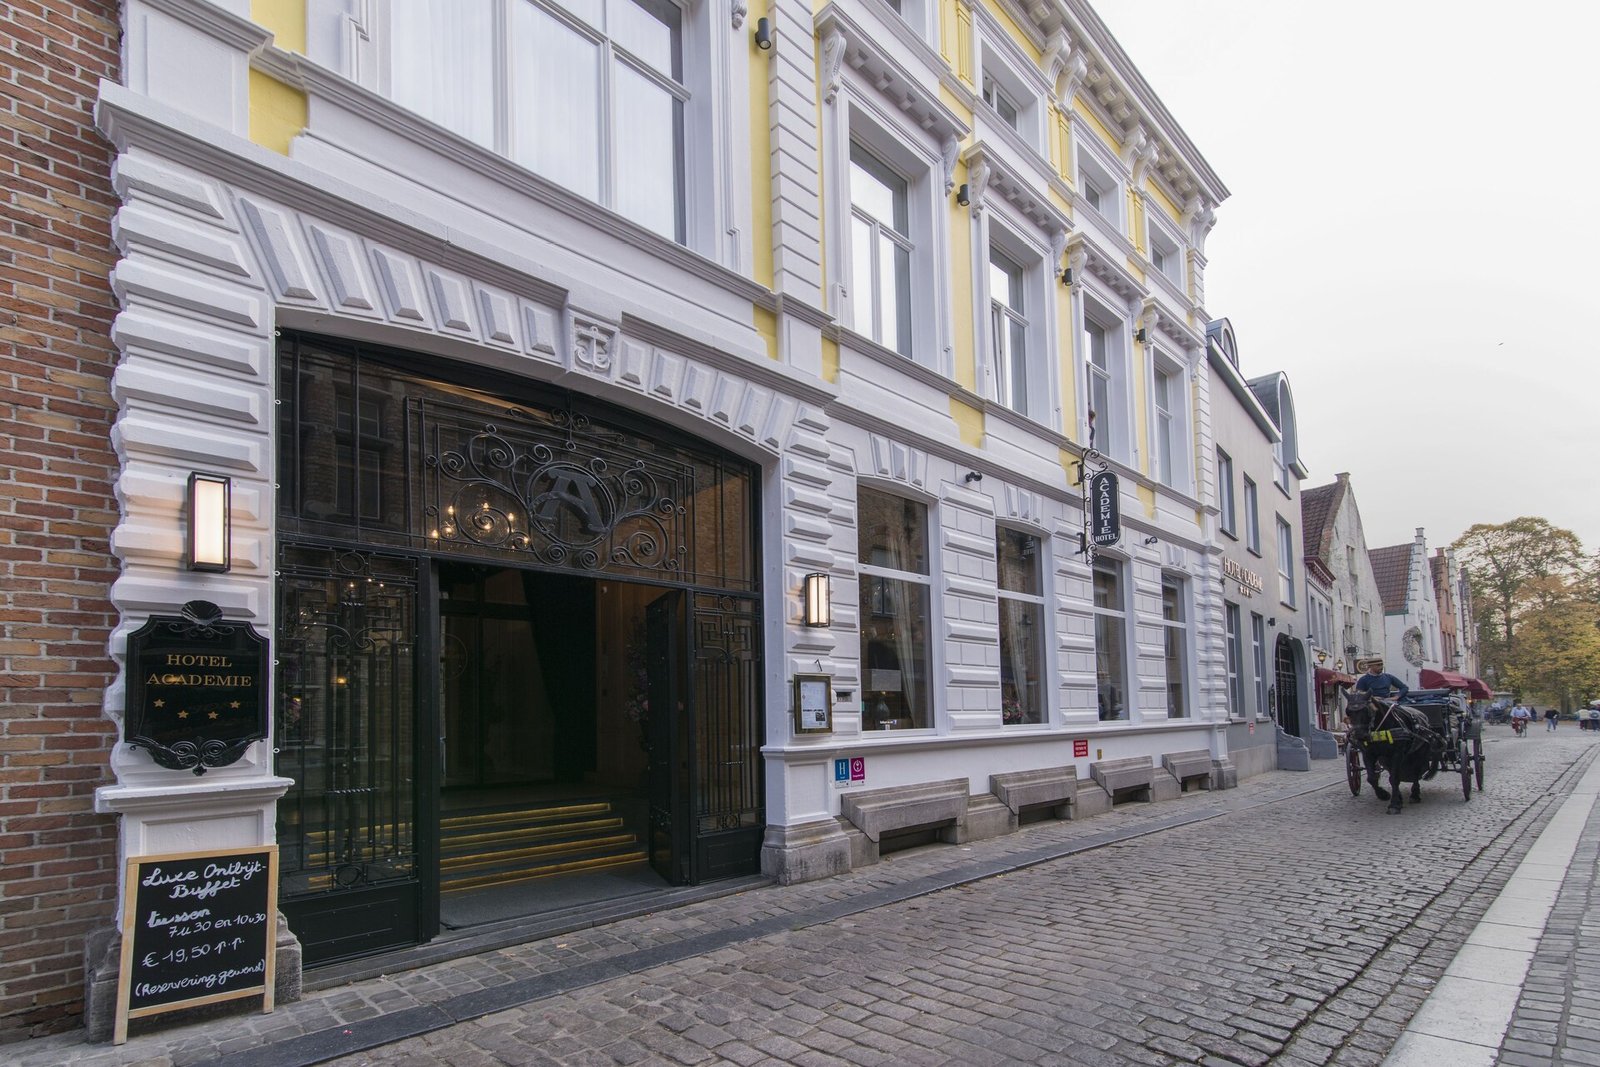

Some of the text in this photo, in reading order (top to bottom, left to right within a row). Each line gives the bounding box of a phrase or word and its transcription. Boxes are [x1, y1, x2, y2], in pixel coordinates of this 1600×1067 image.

[1099, 477, 1112, 535] ACADEMIE
[1095, 533, 1118, 543] HOTEL
[166, 654, 232, 668] HOTEL
[146, 673, 252, 687] ACADEMIE
[839, 761, 846, 775] H
[142, 867, 199, 887] Luxe
[168, 876, 240, 900] Buffet
[147, 908, 211, 928] tussen
[214, 918, 232, 928] en
[135, 974, 218, 997] (Reservering
